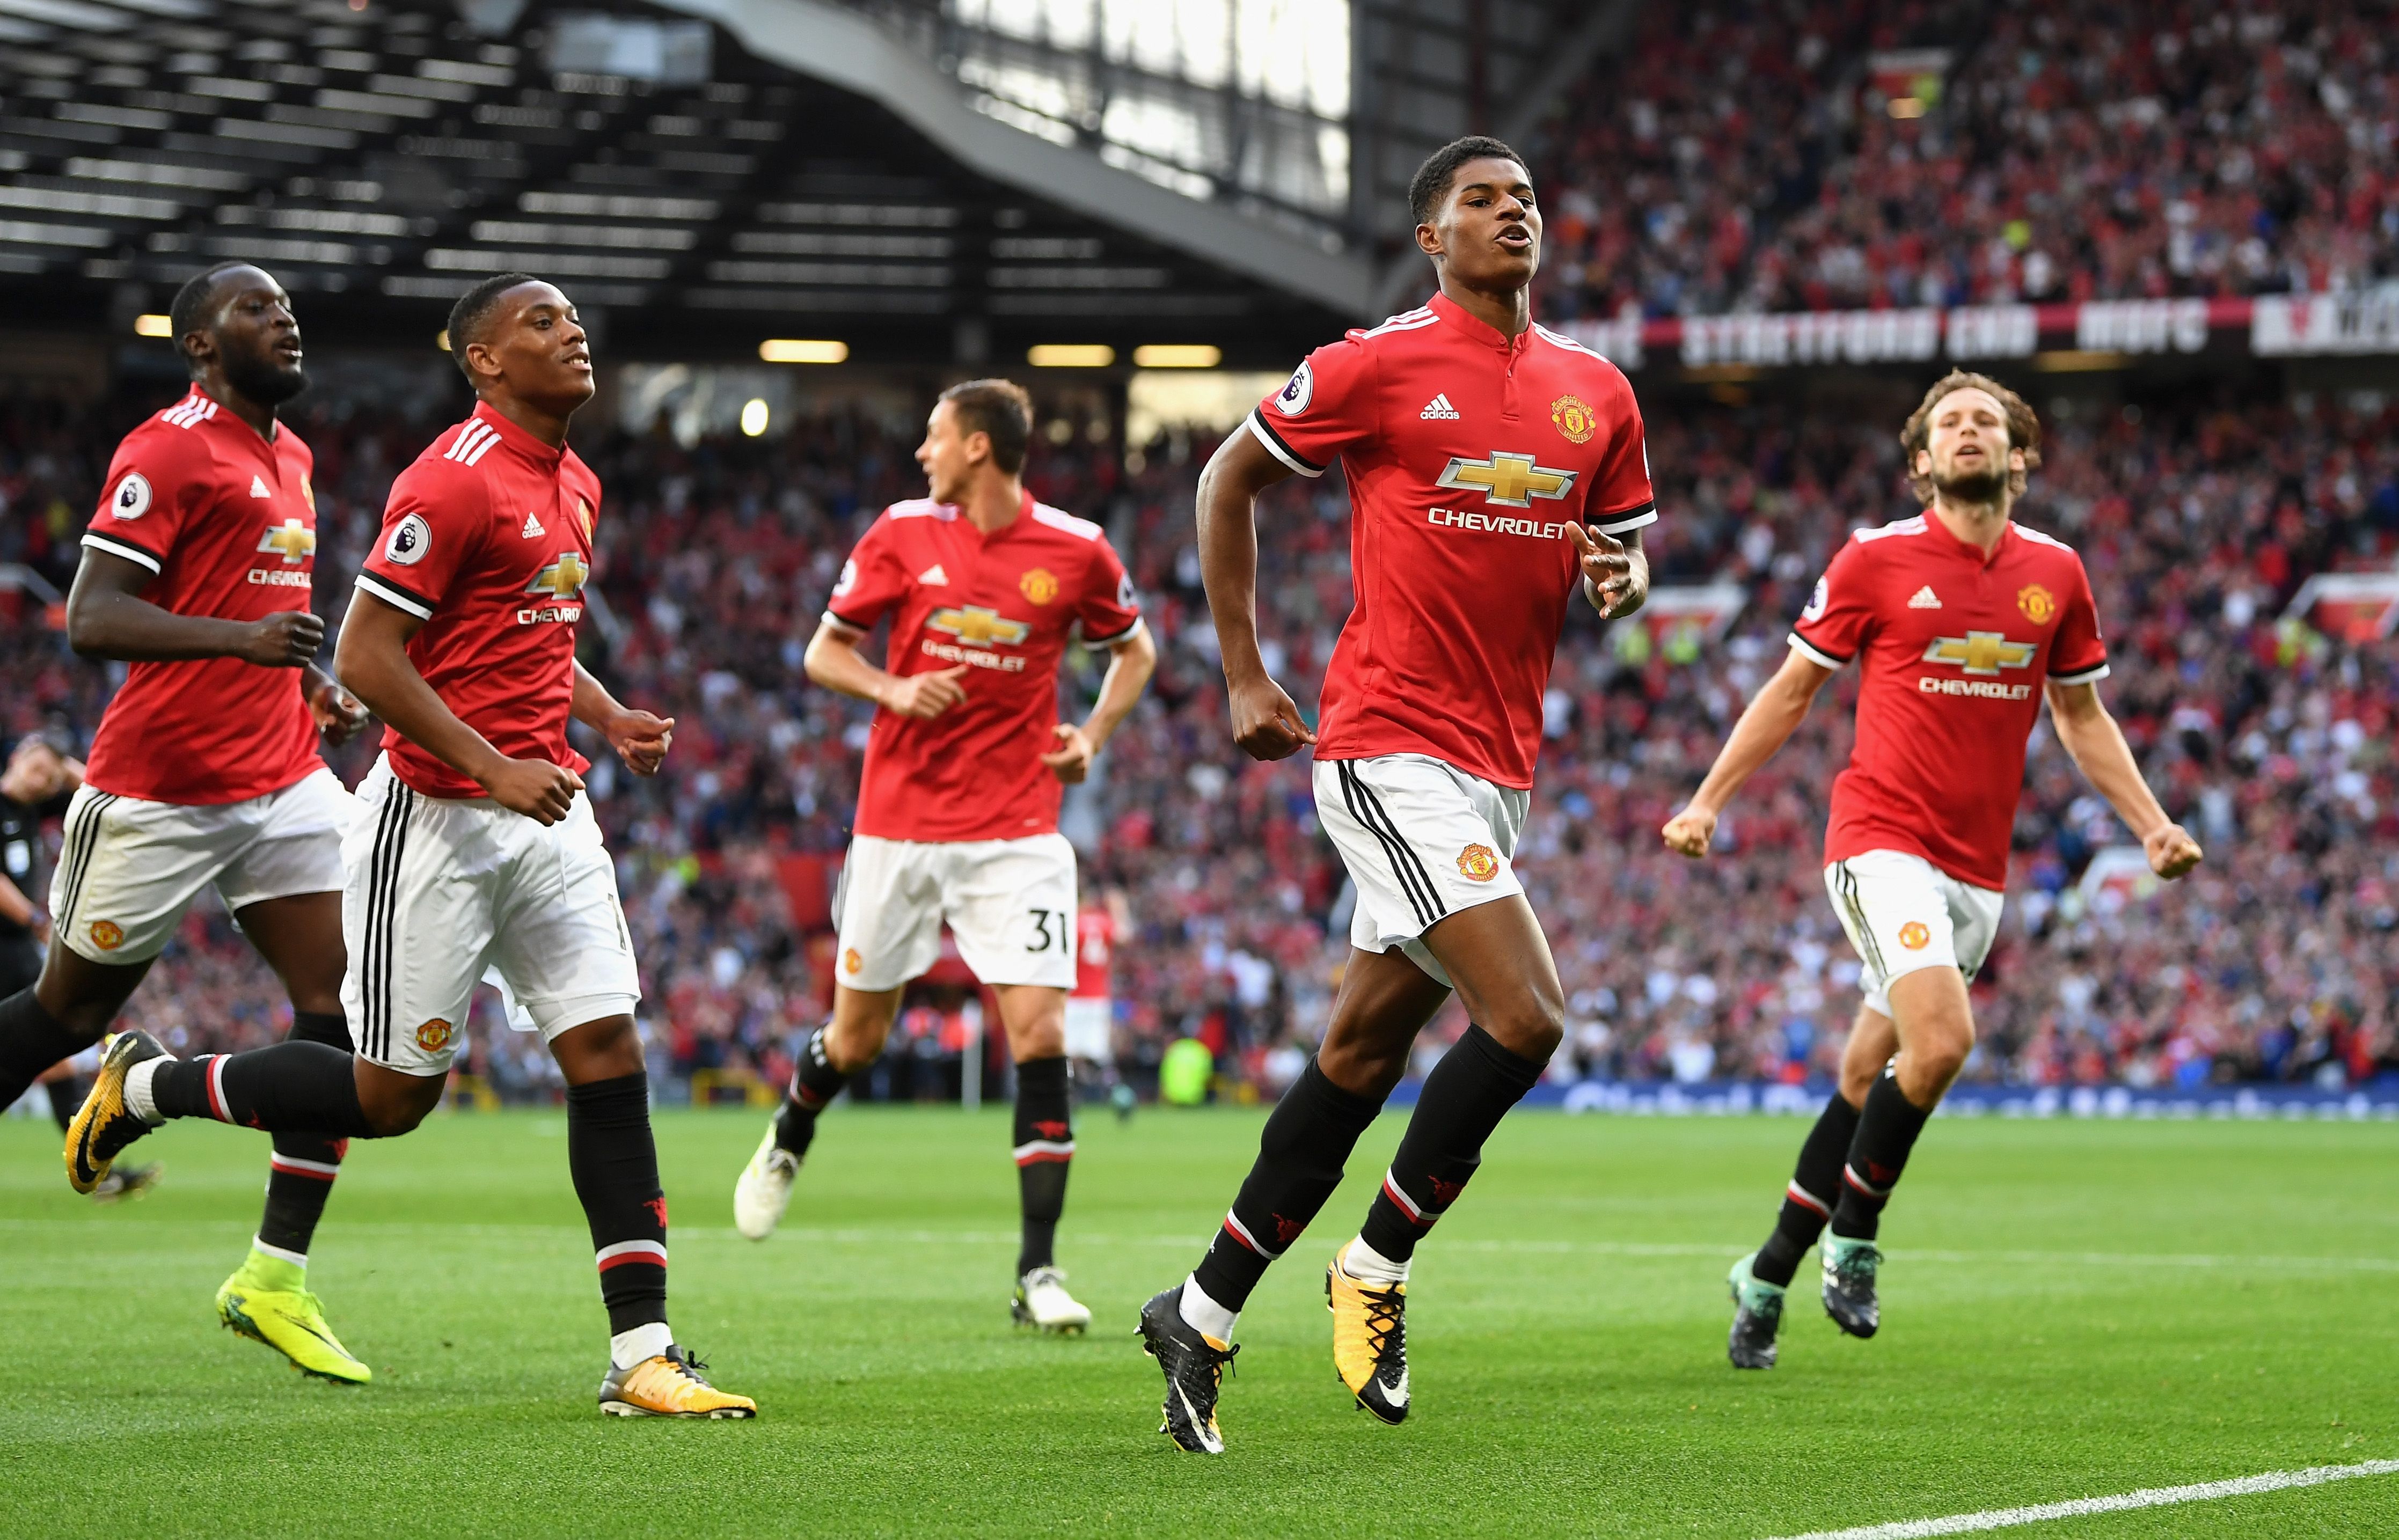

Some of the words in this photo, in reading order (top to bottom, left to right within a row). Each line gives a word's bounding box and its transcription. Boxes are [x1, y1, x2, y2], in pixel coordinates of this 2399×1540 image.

[1420, 409, 1460, 420] adidas
[1554, 398, 1591, 416] MANCHESTER
[1563, 430, 1589, 440] UNITED
[1428, 507, 1566, 540] CHEVROLET
[921, 639, 1026, 673] CHEVROLET
[1918, 676, 2032, 700] CHEVROLET
[1026, 909, 1067, 954] 31
